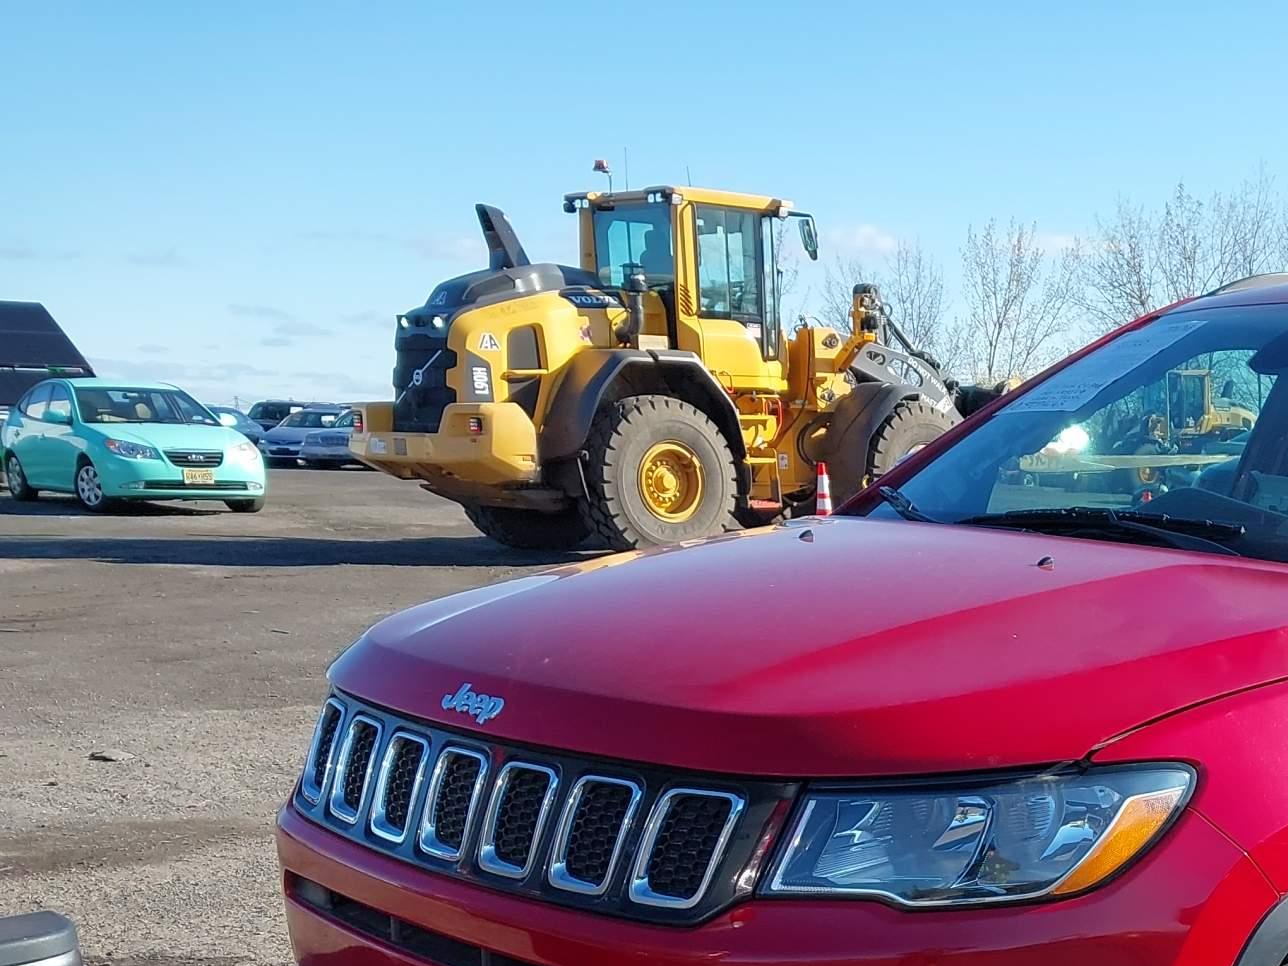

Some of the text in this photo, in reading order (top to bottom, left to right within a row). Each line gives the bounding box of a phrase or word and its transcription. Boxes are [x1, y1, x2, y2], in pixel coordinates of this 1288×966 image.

[569, 295, 619, 304] VOLVO
[472, 366, 489, 395] L90H
[441, 682, 505, 725] Jeep
